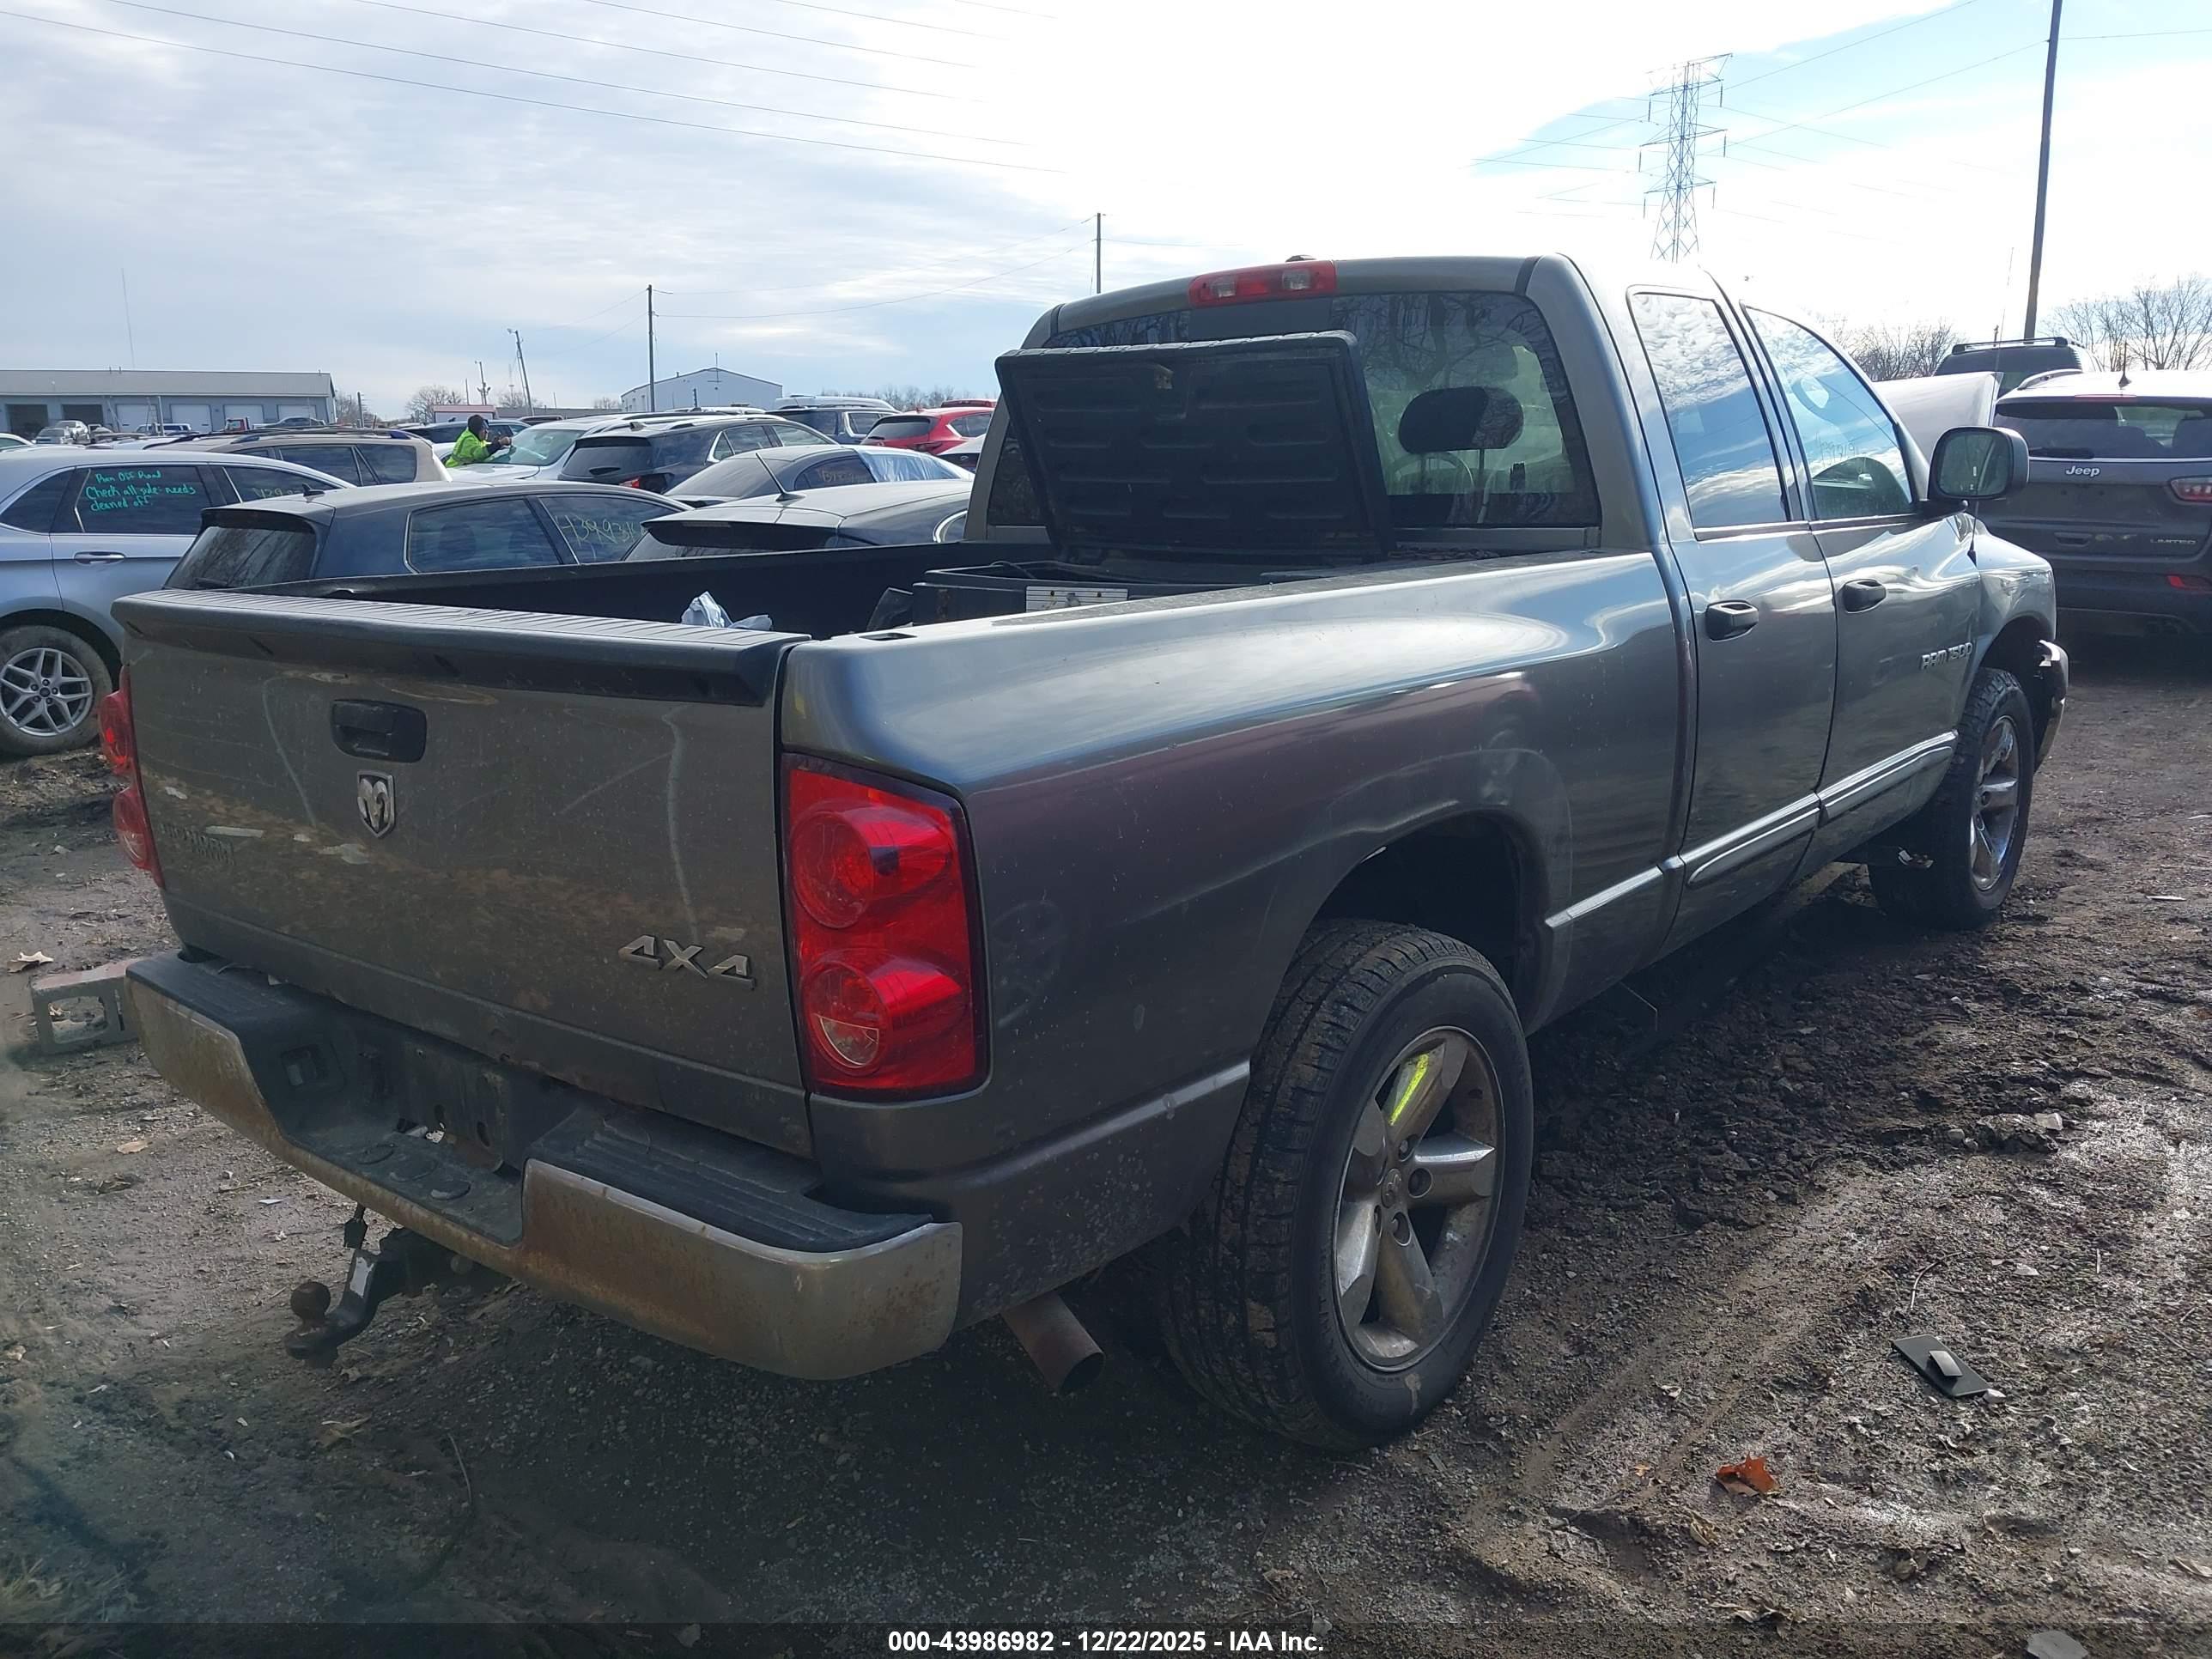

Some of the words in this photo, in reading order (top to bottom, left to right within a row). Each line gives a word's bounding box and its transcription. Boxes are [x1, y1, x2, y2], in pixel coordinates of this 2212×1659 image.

[2065, 465, 2100, 477] Jeep
[85, 484, 121, 500] Check
[123, 483, 137, 496] all
[165, 483, 196, 495] needs
[90, 497, 129, 512] cleaned
[1920, 650, 1948, 670] RAM
[1948, 641, 1973, 660] 1500
